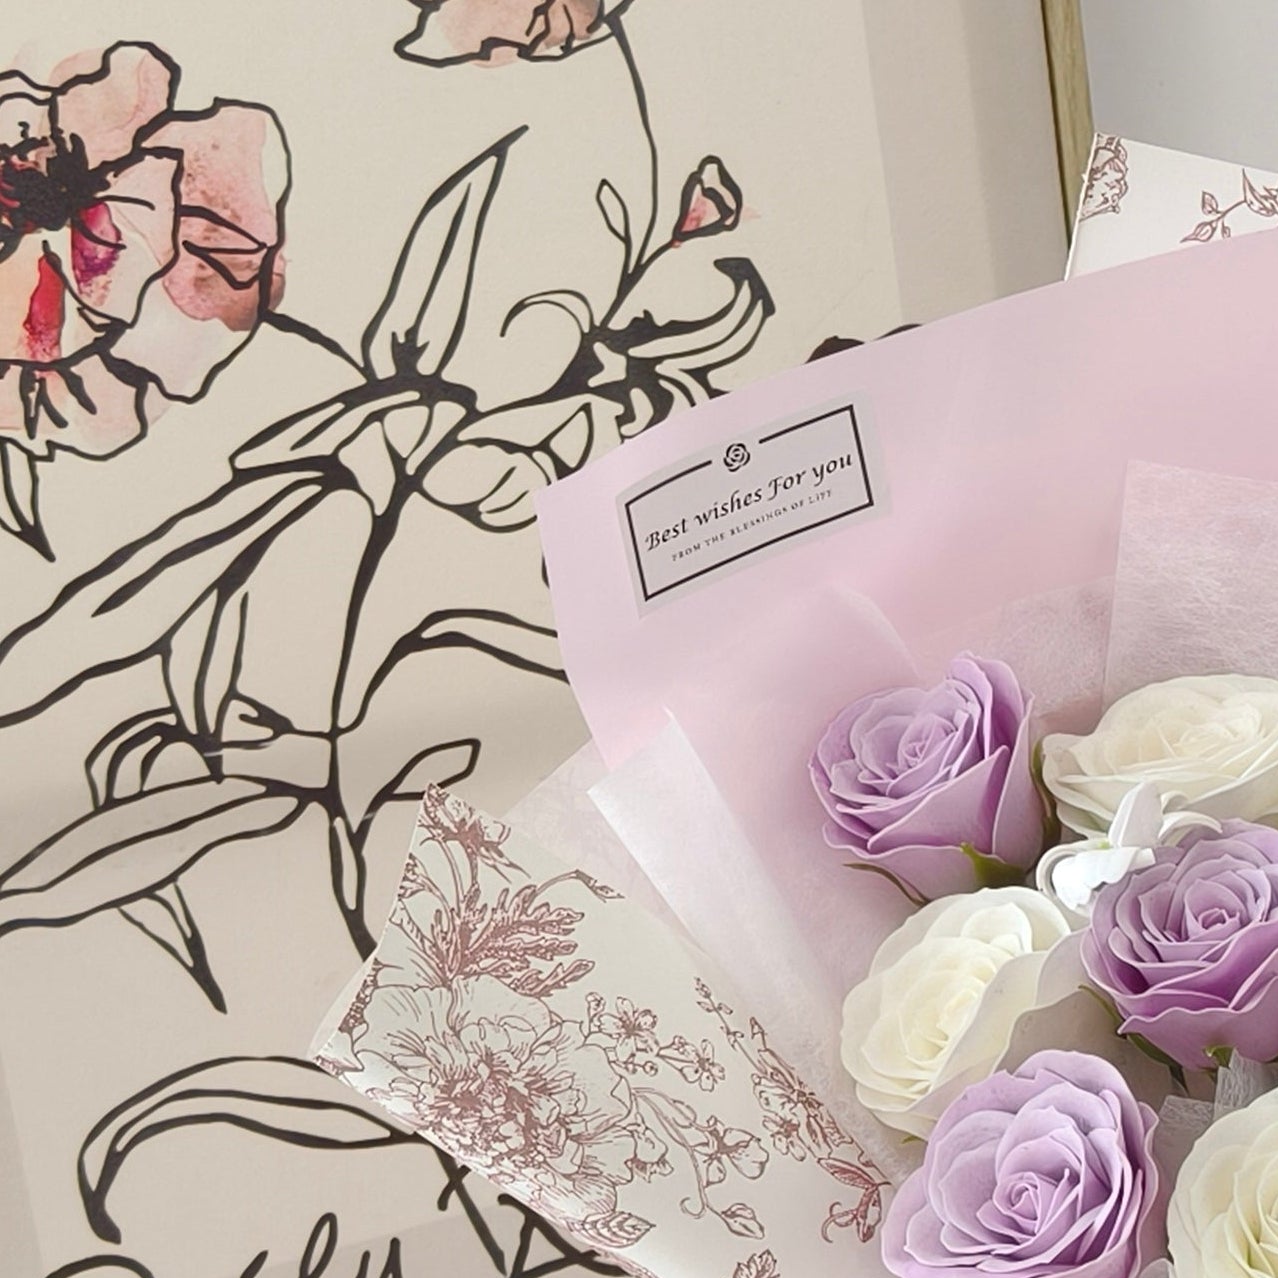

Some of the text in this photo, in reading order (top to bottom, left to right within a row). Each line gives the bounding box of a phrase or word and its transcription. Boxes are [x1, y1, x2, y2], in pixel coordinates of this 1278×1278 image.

[644, 454, 853, 552] Best wishes For you
[671, 543, 701, 562] FROM
[704, 533, 726, 547] THE
[791, 499, 804, 511] OF
